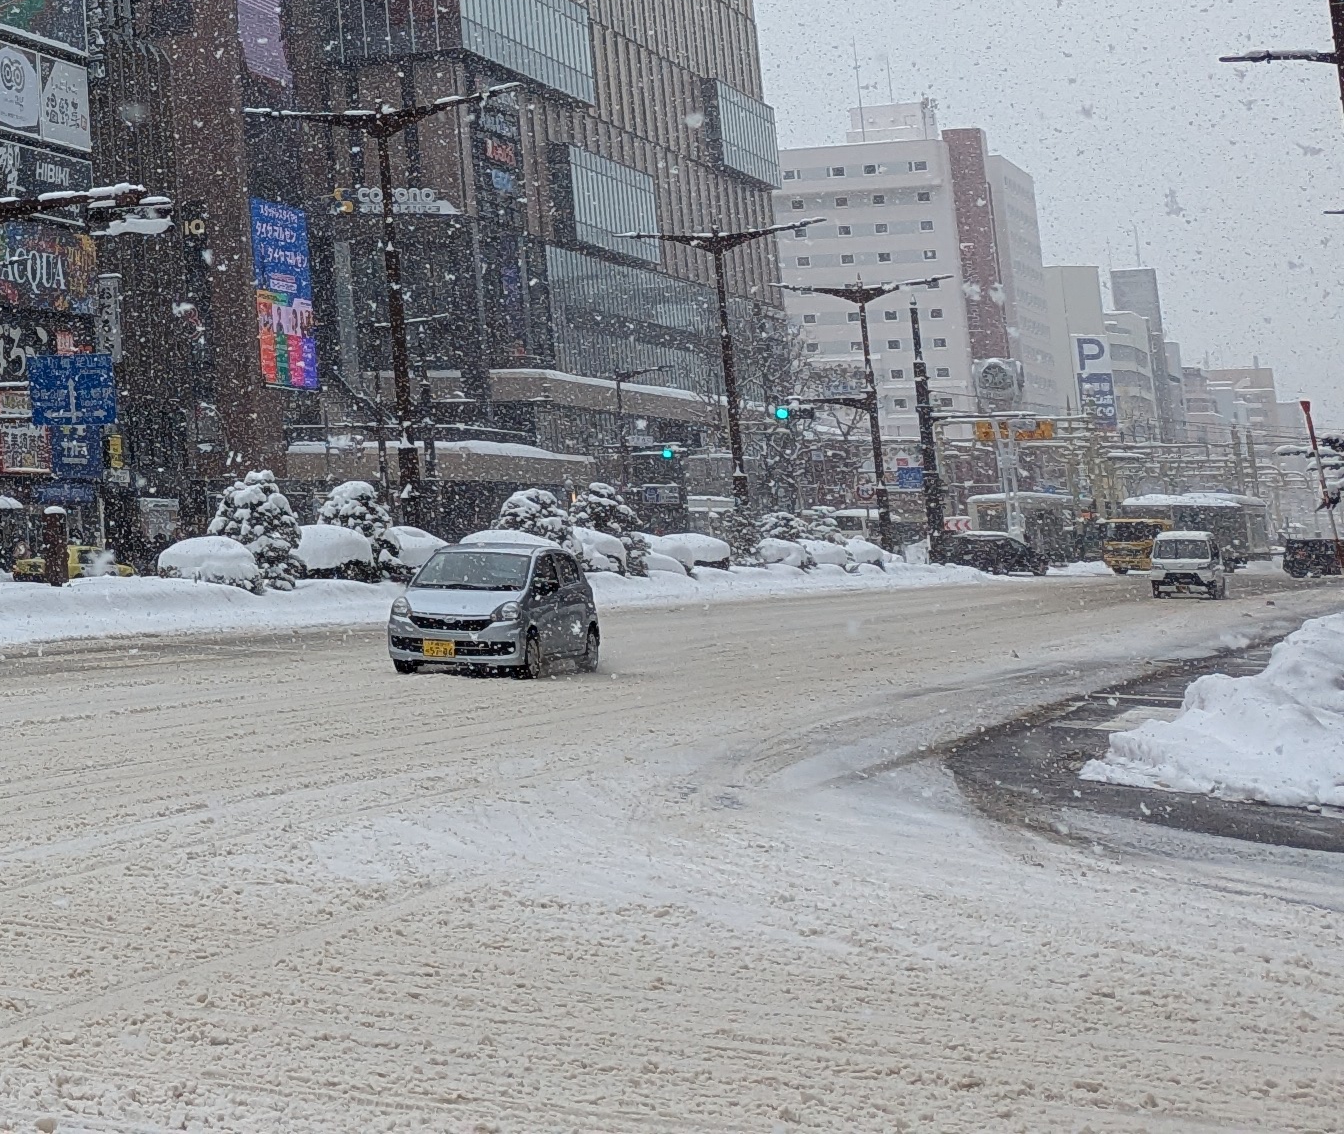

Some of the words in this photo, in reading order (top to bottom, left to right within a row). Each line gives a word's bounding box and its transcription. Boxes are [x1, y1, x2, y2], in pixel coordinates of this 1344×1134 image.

[35, 161, 70, 188] HIBIKI
[358, 187, 439, 202] coono
[0, 247, 67, 294] ACQUA
[1076, 338, 1105, 371] P
